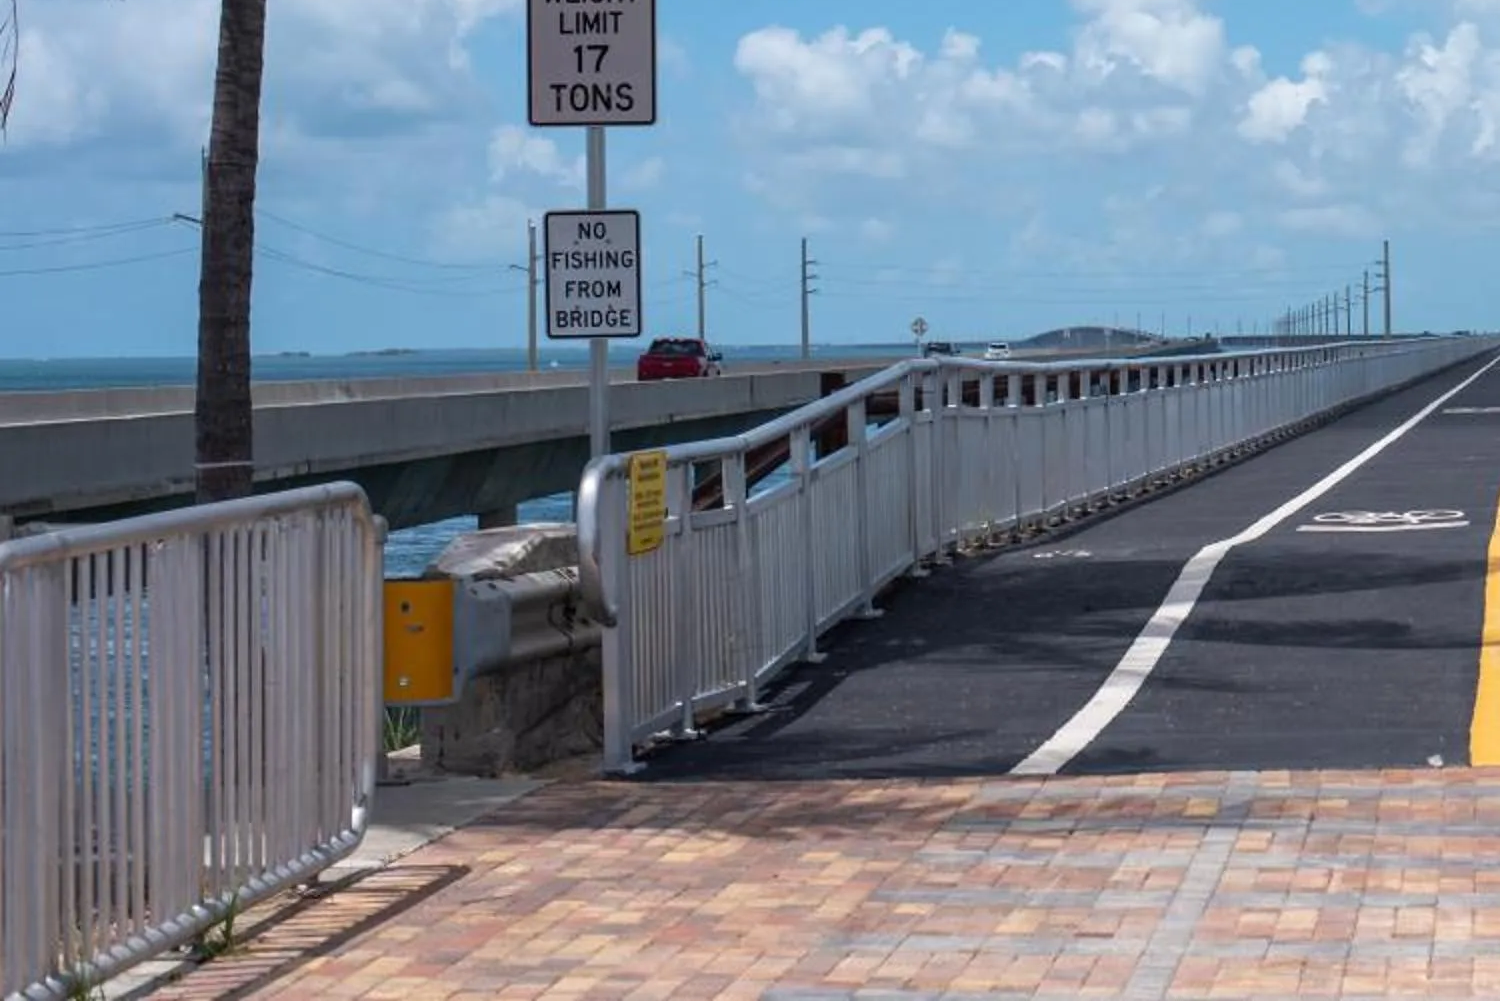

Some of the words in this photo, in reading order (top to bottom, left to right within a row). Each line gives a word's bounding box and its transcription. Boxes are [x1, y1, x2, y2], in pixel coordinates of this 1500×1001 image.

[559, 11, 623, 35] LIMIT
[572, 44, 609, 73] 17
[549, 83, 634, 111] TONS
[577, 222, 607, 240] NO
[551, 250, 633, 269] FISHING
[564, 280, 621, 298] FROM
[555, 309, 631, 327] BRIDGE
